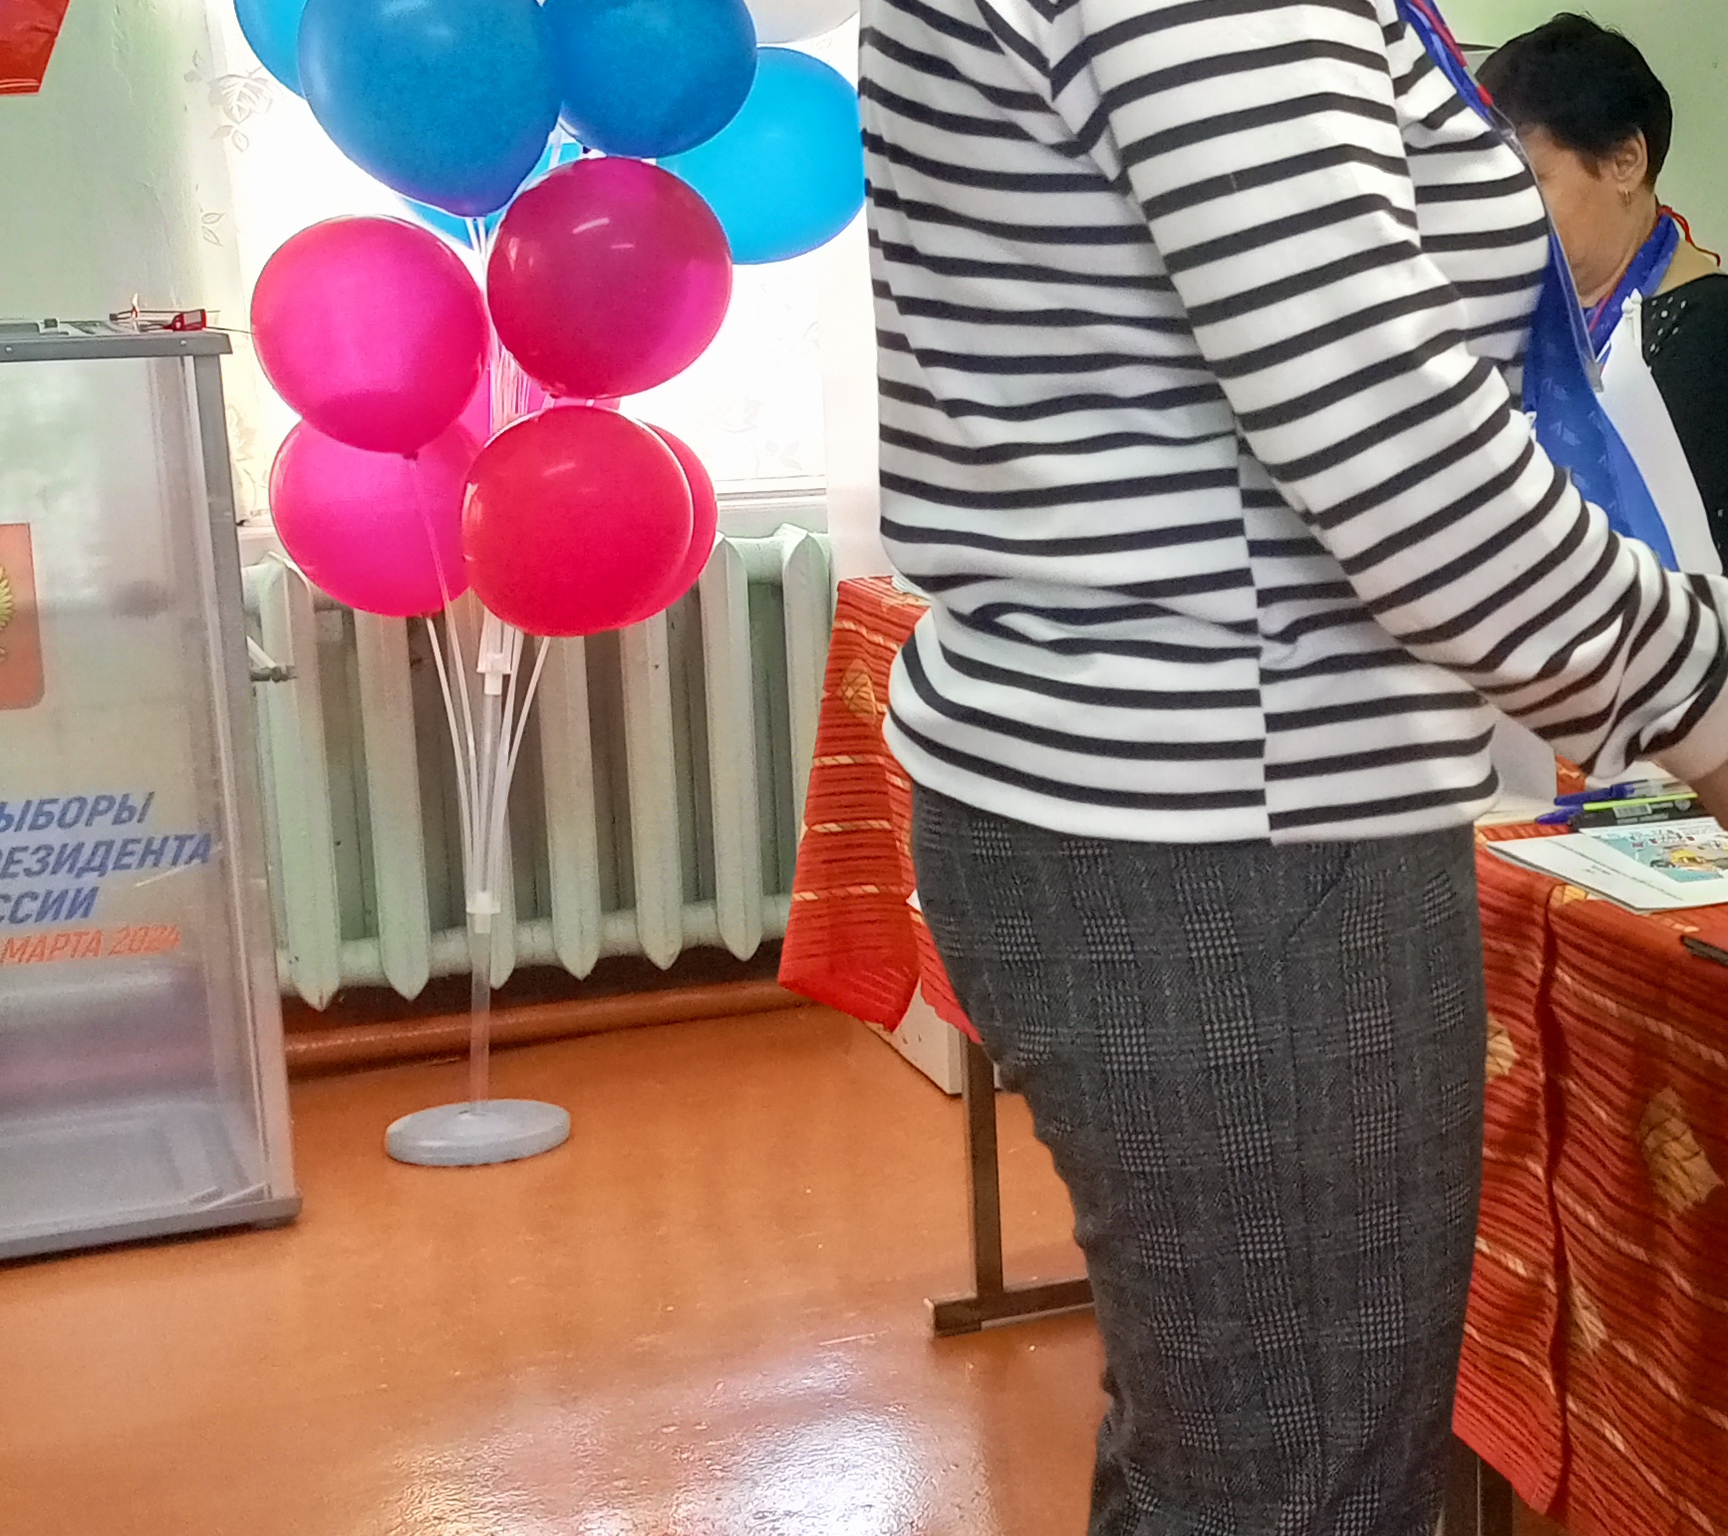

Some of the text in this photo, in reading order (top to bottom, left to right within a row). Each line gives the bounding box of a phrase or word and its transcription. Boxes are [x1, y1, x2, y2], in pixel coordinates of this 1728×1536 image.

[0, 791, 156, 833] ЫБОРЫ
[0, 833, 212, 879] ЕЗИДЕНТА
[0, 928, 105, 965] МАРТА
